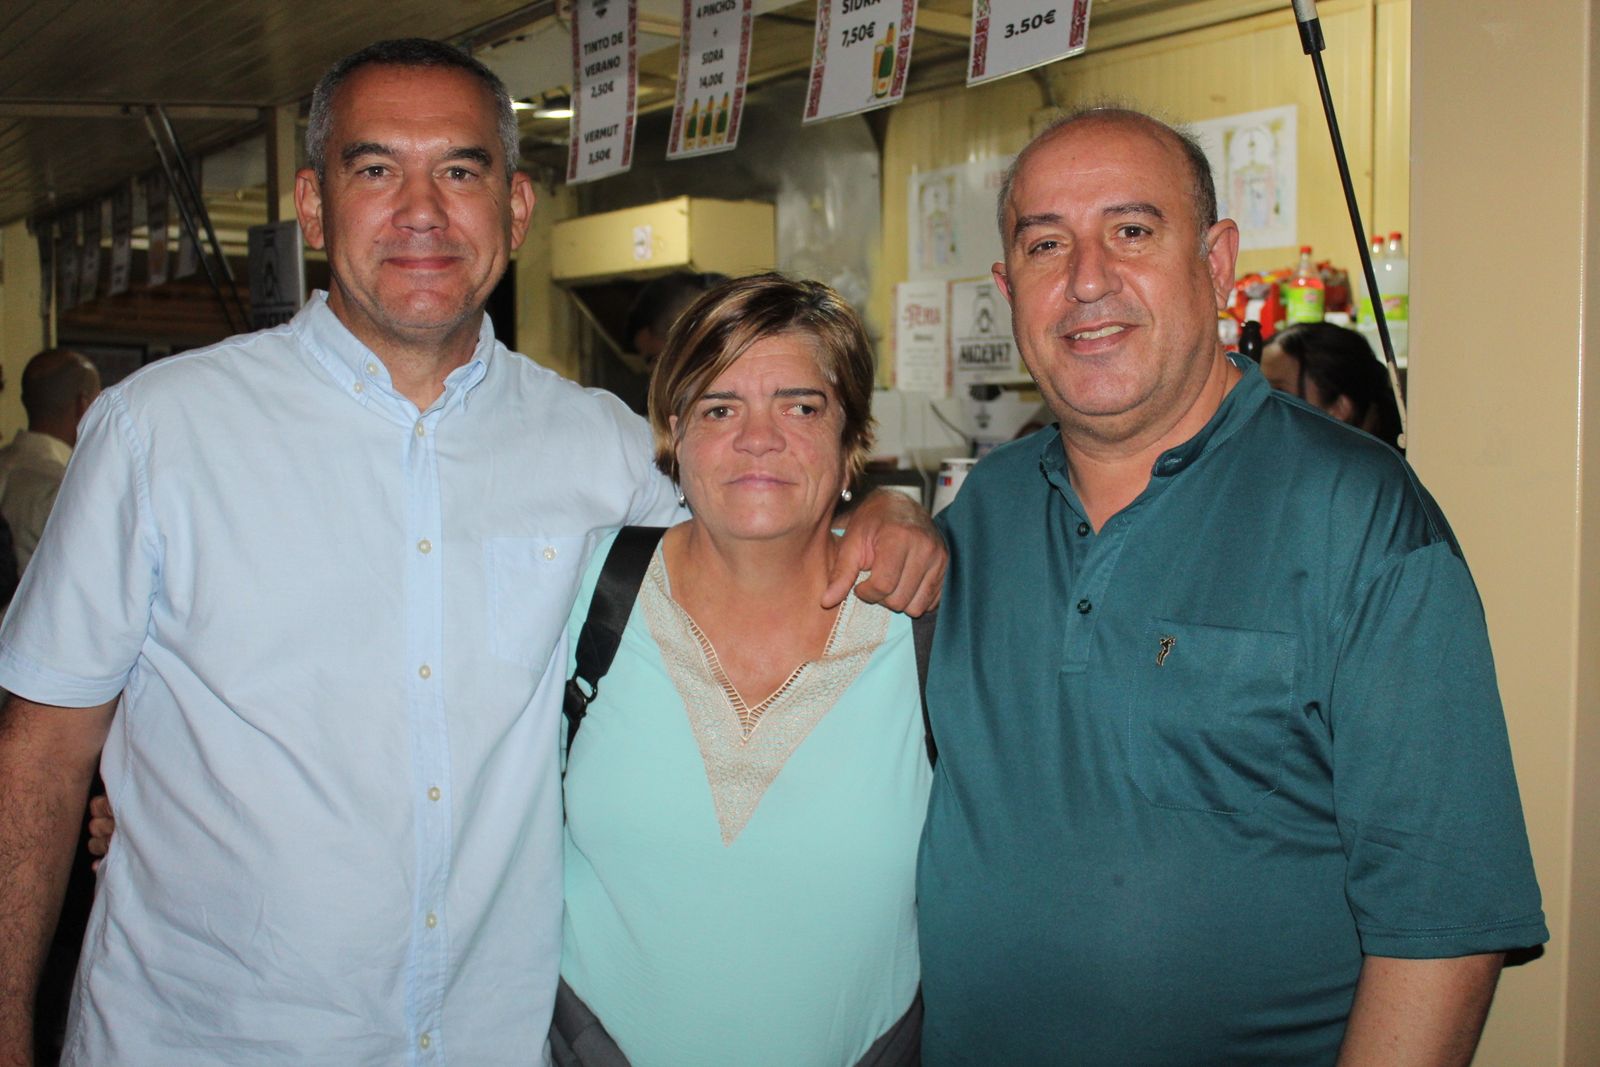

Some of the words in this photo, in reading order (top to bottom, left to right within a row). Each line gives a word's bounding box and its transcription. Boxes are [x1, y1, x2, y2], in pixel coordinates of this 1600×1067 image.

[702, 0, 736, 17] PINCHOS
[842, 0, 881, 15] SID
[842, 21, 876, 48] 7,50€
[1004, 9, 1057, 39] 3.50€
[584, 36, 610, 56] TINTO
[611, 31, 624, 47] DE
[584, 55, 621, 78] VERANO
[702, 47, 724, 66] SIDRA
[584, 123, 619, 144] VERMUT
